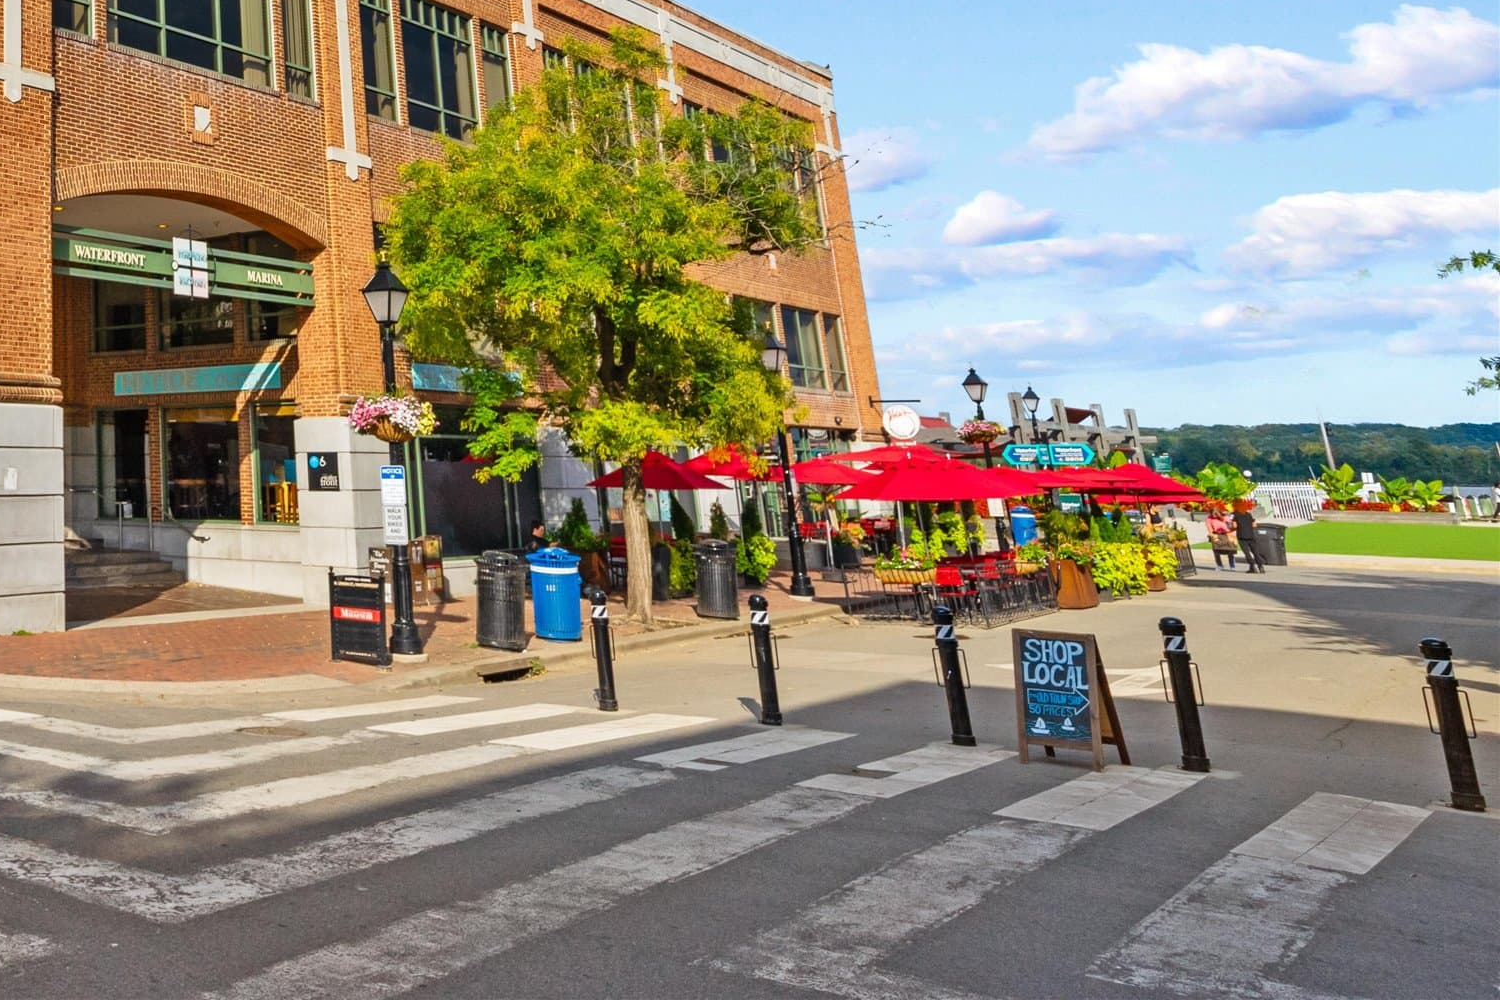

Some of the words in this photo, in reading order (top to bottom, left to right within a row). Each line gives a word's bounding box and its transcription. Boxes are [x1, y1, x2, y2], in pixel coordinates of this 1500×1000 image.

[75, 244, 146, 267] WATERFRONT
[247, 270, 284, 286] MARINA
[319, 455, 327, 467] 6
[320, 478, 338, 487] front
[1023, 638, 1084, 665] SHOP
[1021, 660, 1090, 690] LOCAL
[1036, 692, 1050, 704] OLD
[1028, 703, 1042, 715] 50
